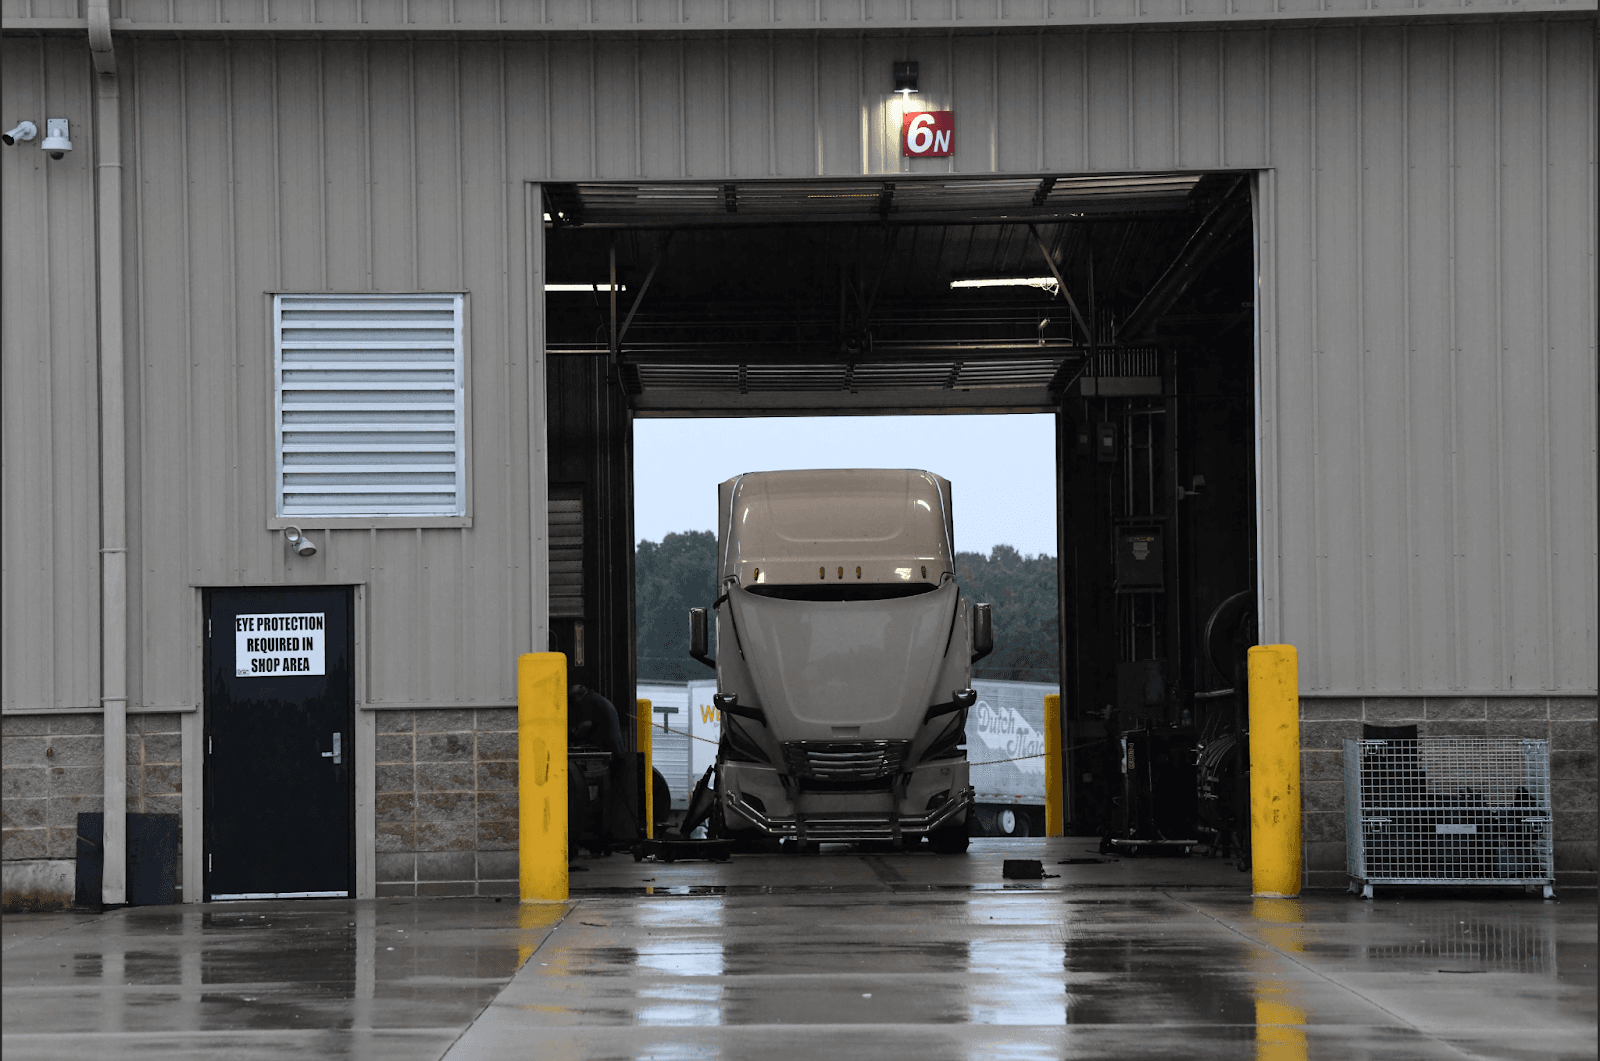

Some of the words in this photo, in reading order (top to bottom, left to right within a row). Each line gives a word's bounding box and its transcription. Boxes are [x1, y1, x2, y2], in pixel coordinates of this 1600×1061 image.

[907, 113, 951, 154] 6N
[236, 617, 254, 632] EYE
[257, 616, 323, 631] PROTECTION
[247, 637, 299, 653] REQUIRED
[302, 637, 313, 651] IN
[251, 658, 280, 673] SHOP
[282, 657, 310, 671] AREA
[977, 701, 1015, 735] Dutch
